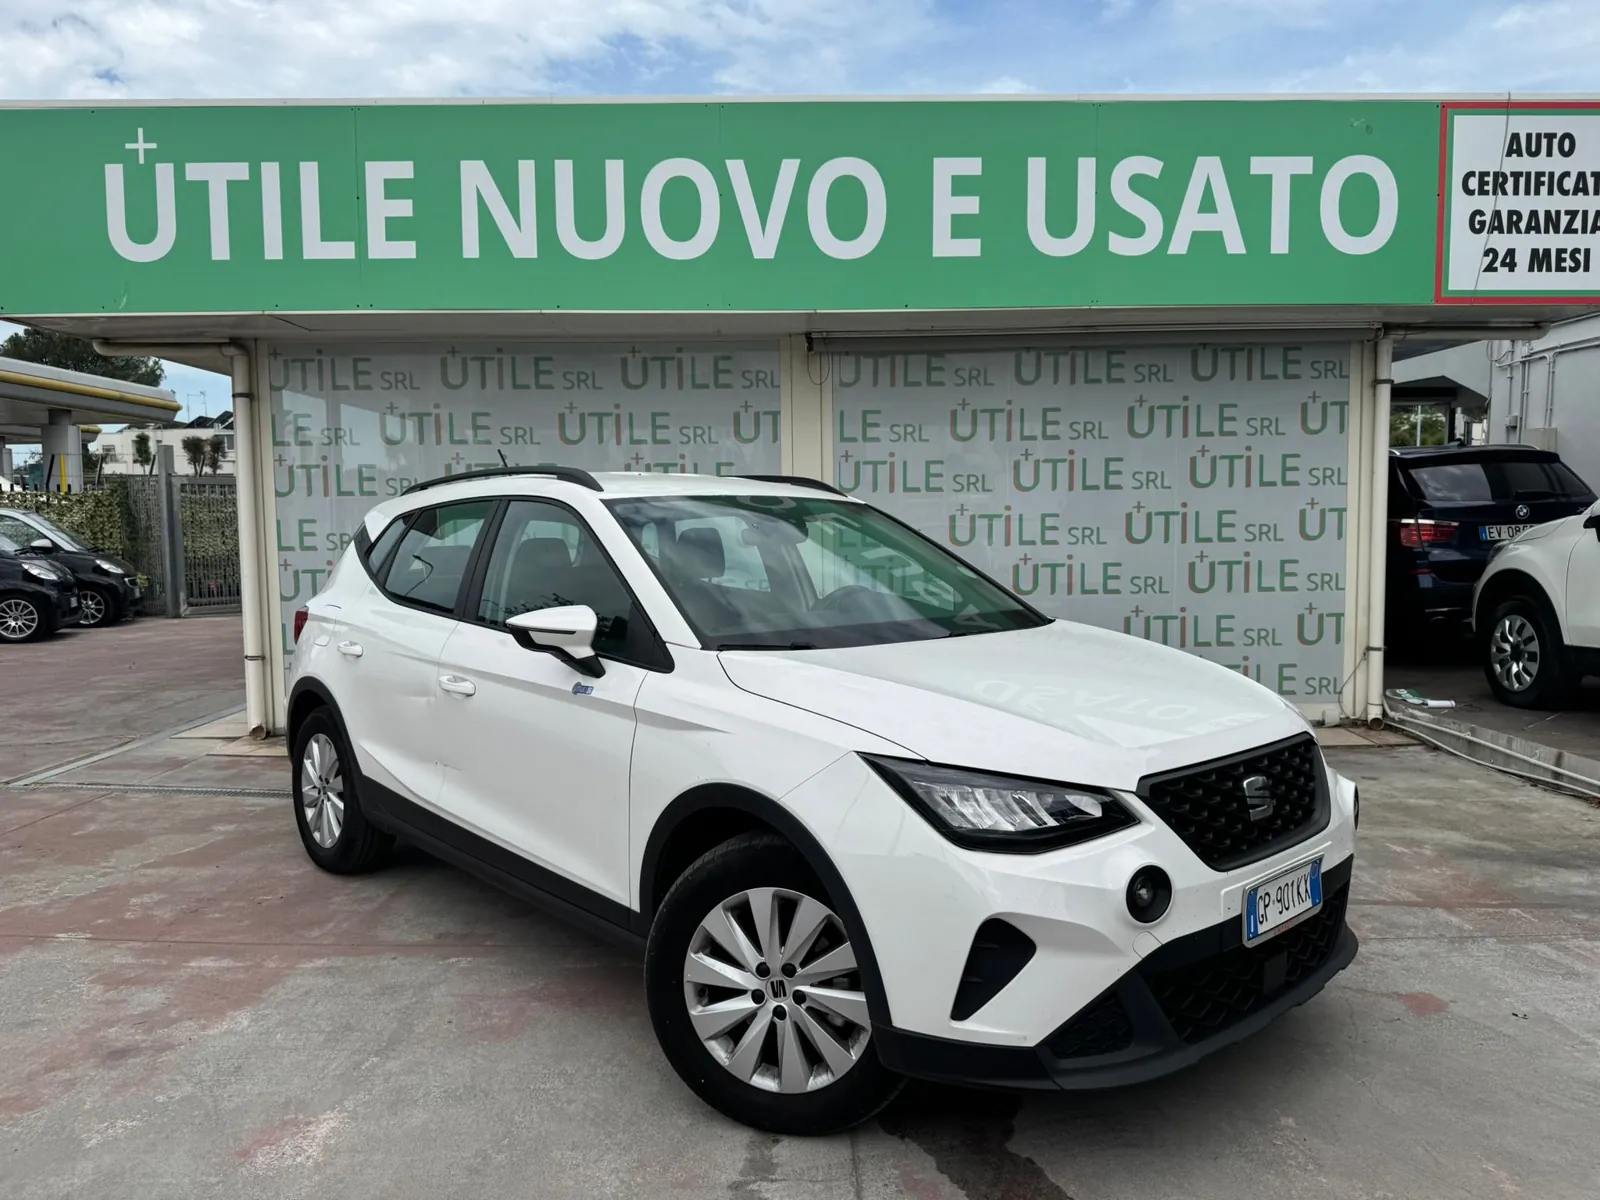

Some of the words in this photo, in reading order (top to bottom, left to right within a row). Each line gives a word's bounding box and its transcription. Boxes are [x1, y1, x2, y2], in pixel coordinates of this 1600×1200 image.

[1505, 132, 1576, 158] AUTO
[460, 156, 886, 261] NUOVO
[932, 157, 982, 257] E
[1027, 155, 1399, 257] USATO
[1469, 209, 1600, 235] GARANZIA
[1482, 248, 1517, 273] 24
[1527, 248, 1591, 273] MESI
[380, 371, 421, 390] SRL
[562, 371, 603, 390] SRL
[741, 369, 780, 389] SRL
[953, 368, 995, 387] SRL
[1134, 364, 1174, 383] SRL
[1310, 360, 1349, 379] SRL
[321, 428, 360, 446] SRL
[500, 426, 541, 445] SRL
[679, 426, 719, 445] SRL
[889, 424, 930, 443] SRL
[1069, 421, 1109, 440] SRL
[1246, 417, 1286, 436] SRL
[952, 474, 993, 492] SRL
[1131, 471, 1172, 490] SRL
[1308, 467, 1348, 486] SRL
[1067, 527, 1107, 545] SRL
[1244, 524, 1284, 542] SRL
[1129, 576, 1170, 594] SRL
[1306, 573, 1345, 591] SRL
[1243, 628, 1283, 646] SRL
[1304, 677, 1343, 695] SRL
